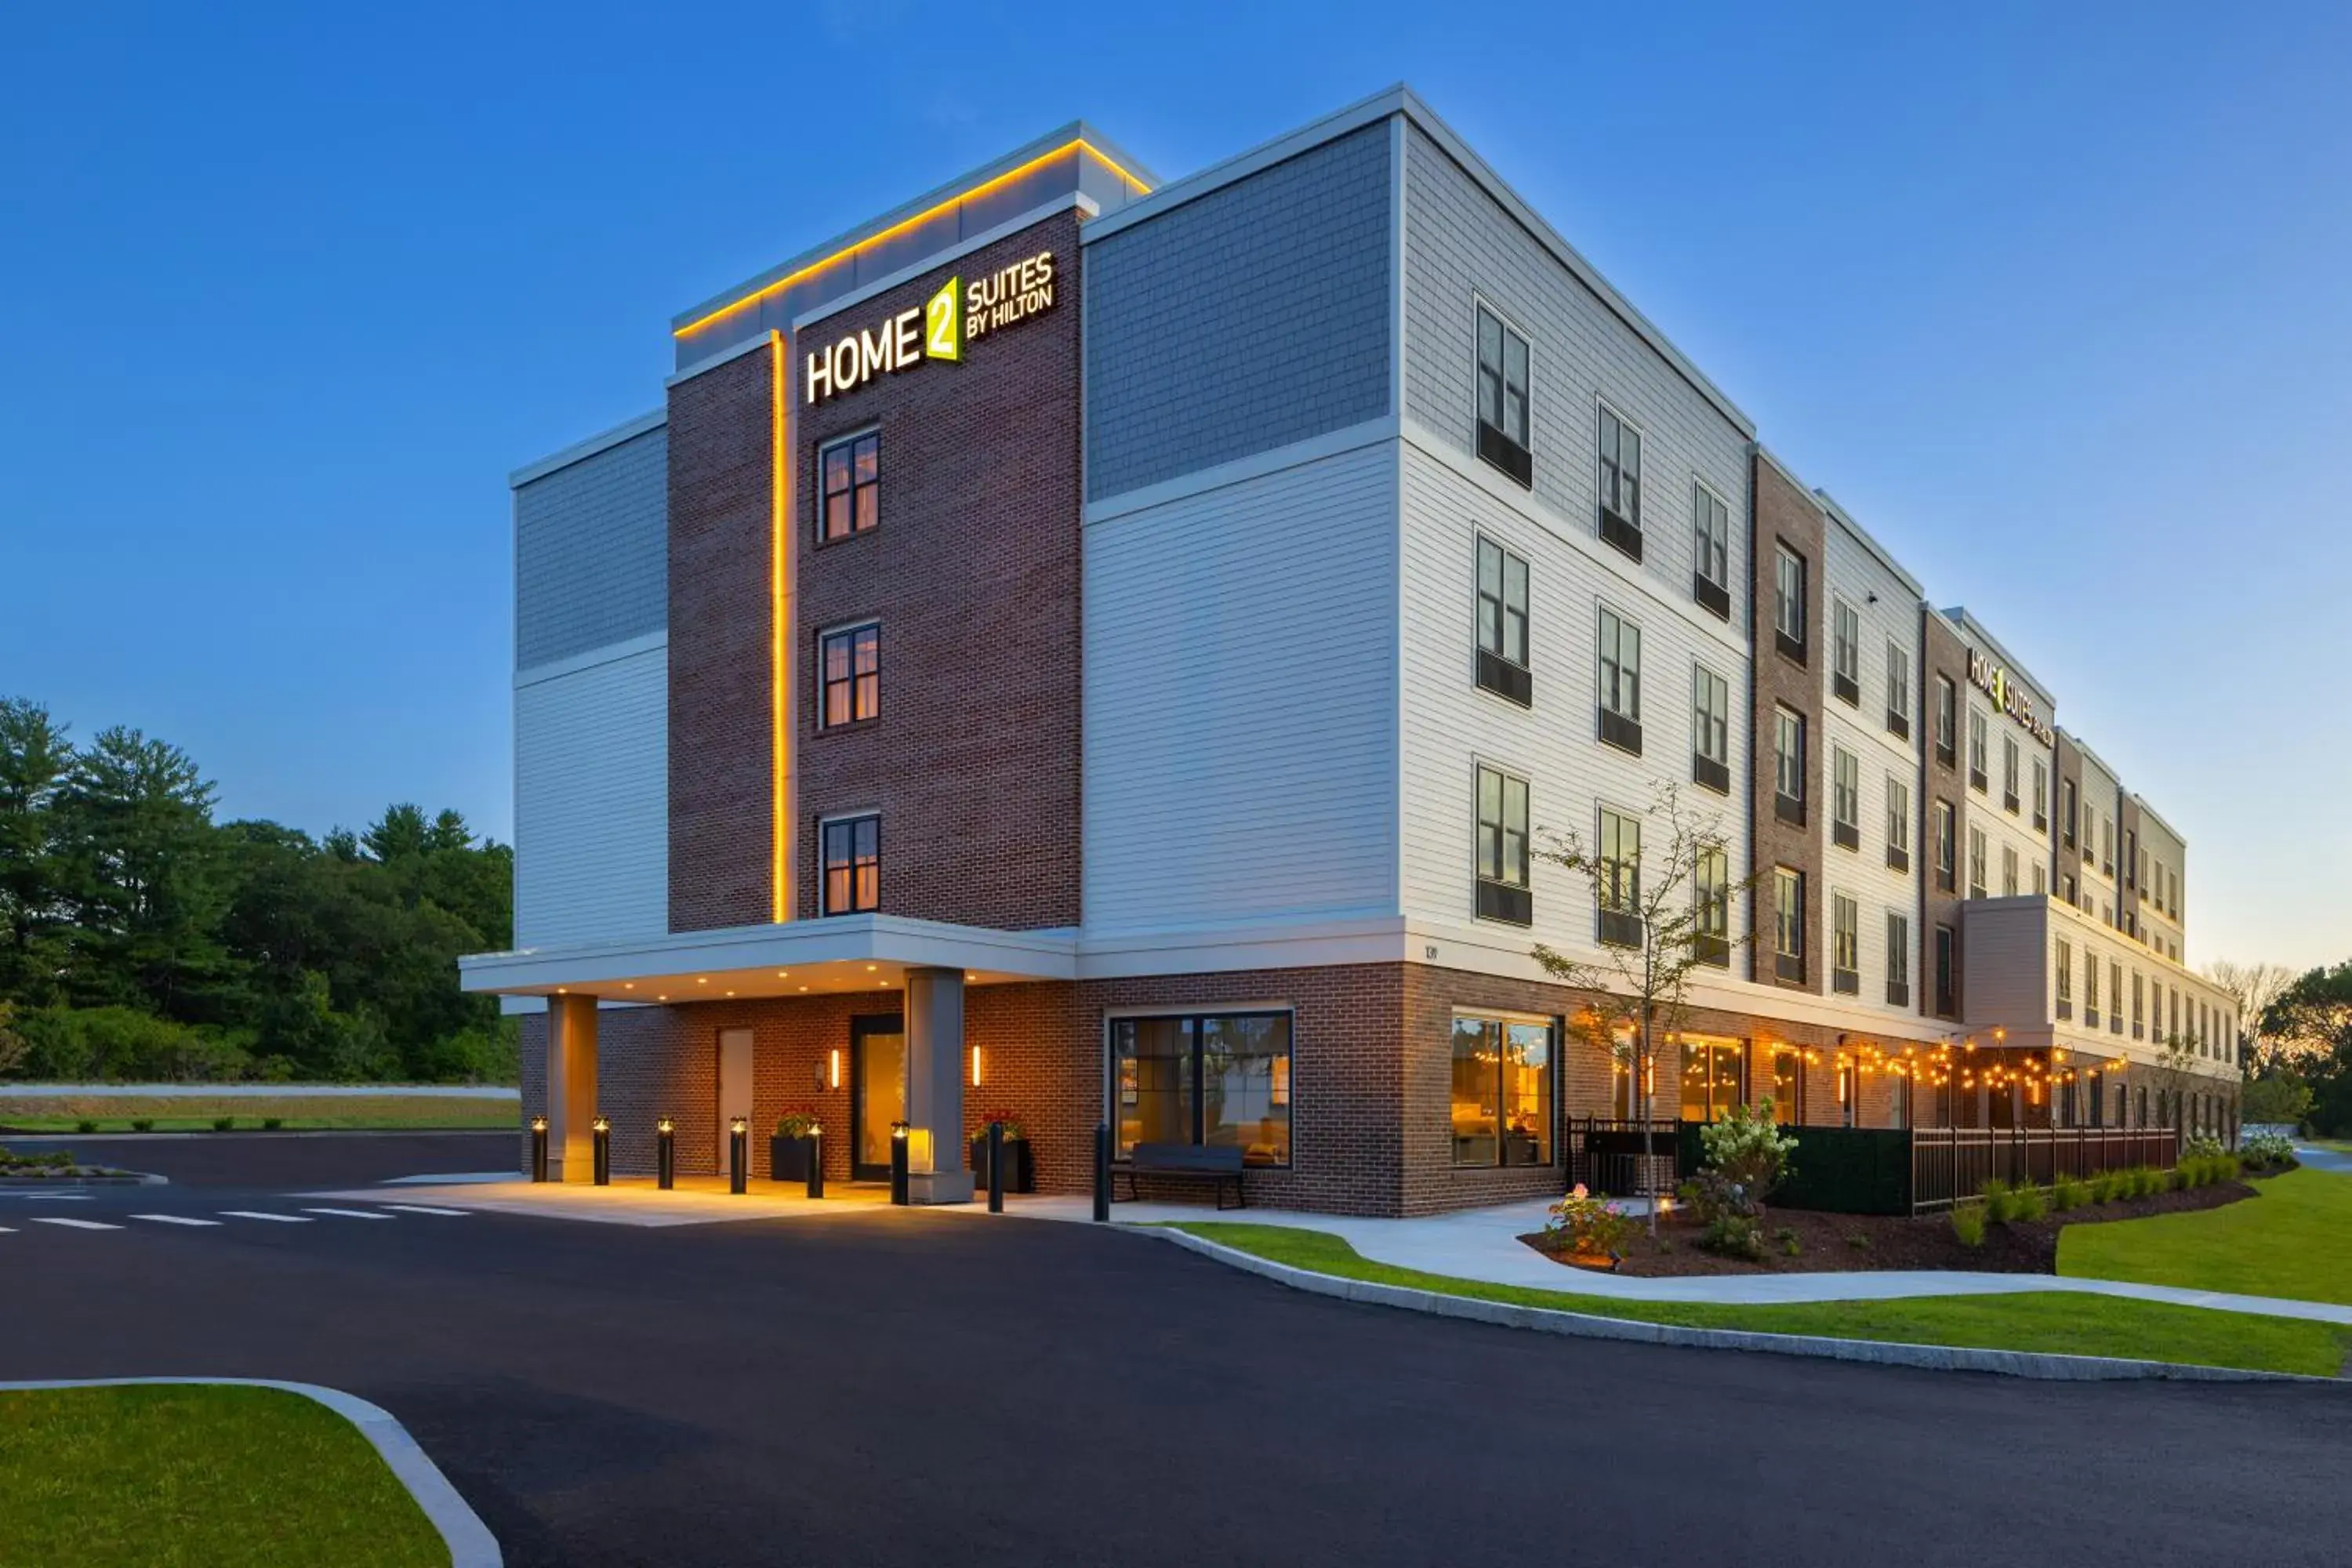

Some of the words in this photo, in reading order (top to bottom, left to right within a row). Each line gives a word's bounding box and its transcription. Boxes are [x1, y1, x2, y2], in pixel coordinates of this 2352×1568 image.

[966, 310, 989, 339] BY
[991, 284, 1052, 329] HILTON
[967, 252, 1052, 314] SUITES
[808, 307, 920, 404] HOME
[930, 292, 953, 353] 2
